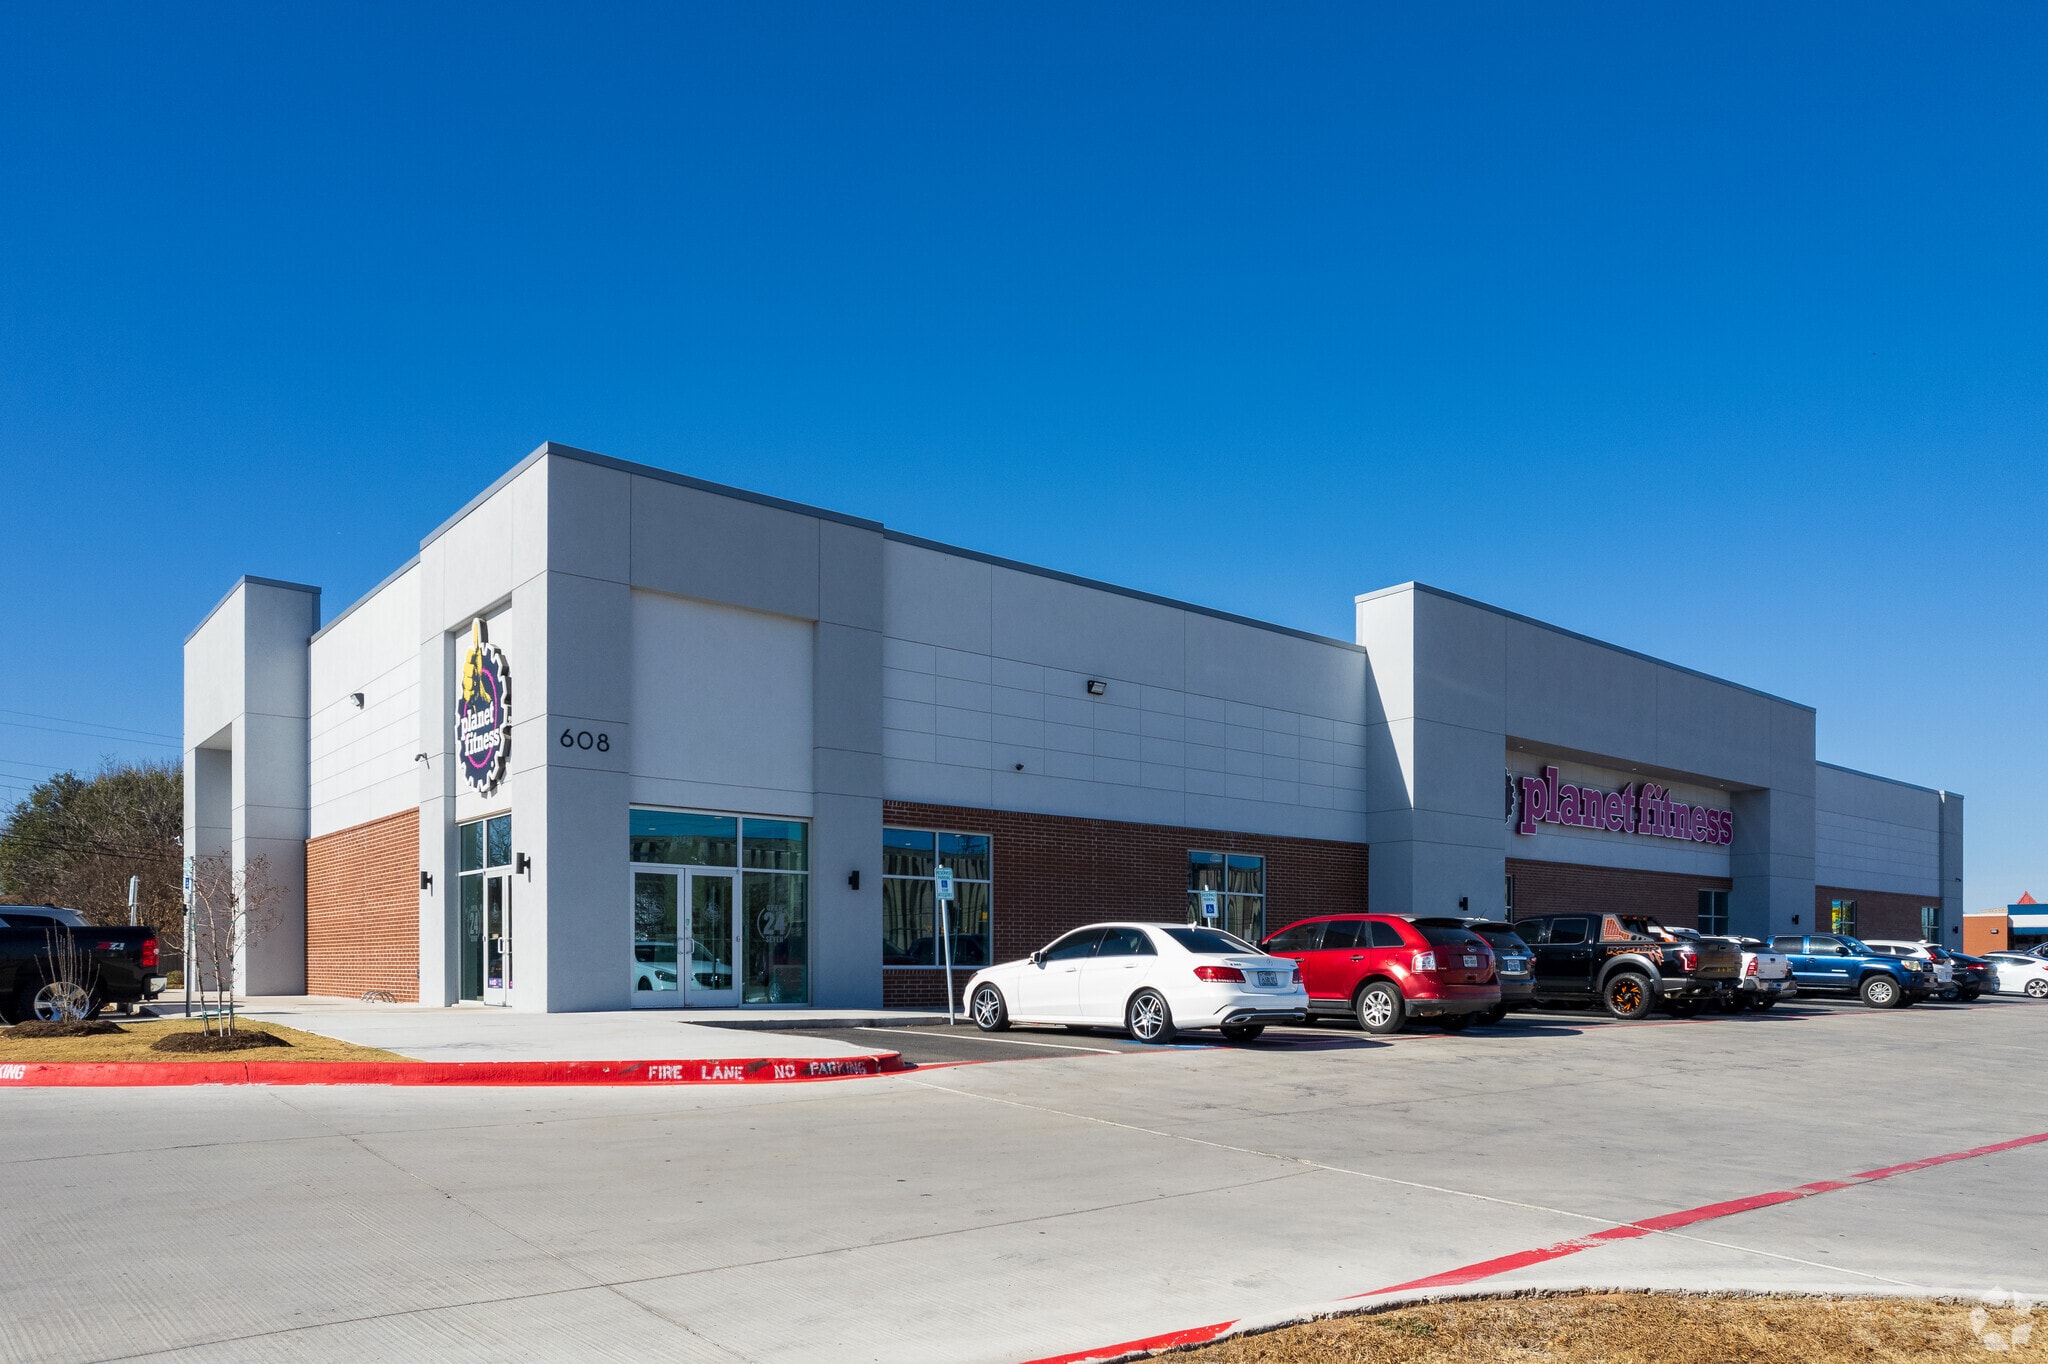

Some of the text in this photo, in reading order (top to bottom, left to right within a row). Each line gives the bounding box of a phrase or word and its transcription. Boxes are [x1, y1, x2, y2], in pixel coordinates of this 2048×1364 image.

[461, 701, 494, 741] planet
[465, 727, 500, 756] fitness
[560, 728, 610, 752] 608
[1520, 765, 1734, 845] planet fitness
[763, 911, 786, 935] 24
[648, 1065, 683, 1080] FIRE
[701, 1065, 744, 1080] LANE
[774, 1064, 796, 1079] NO
